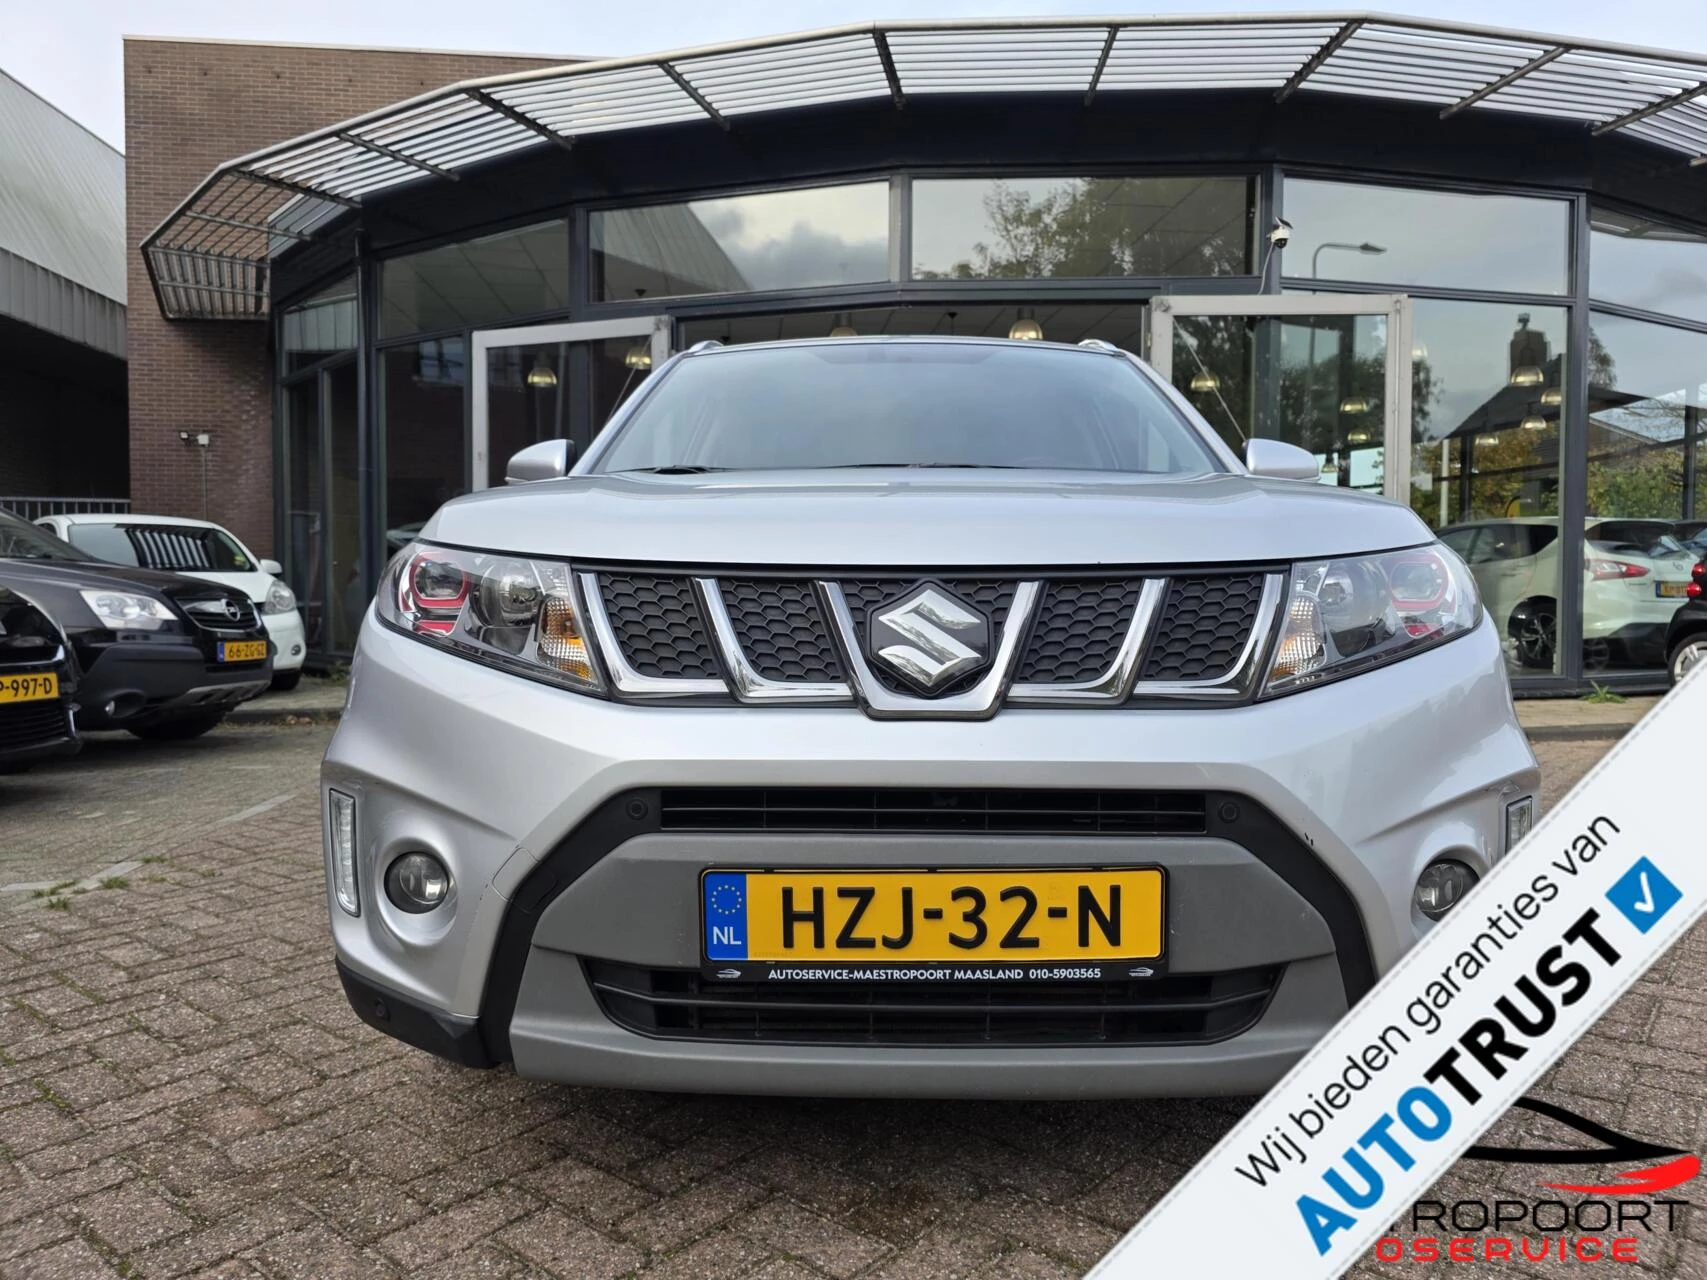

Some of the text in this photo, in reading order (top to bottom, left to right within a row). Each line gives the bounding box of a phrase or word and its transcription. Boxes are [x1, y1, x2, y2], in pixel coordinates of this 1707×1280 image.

[781, 885, 1121, 950] HZJ-32-N
[712, 926, 742, 945] NL
[768, 968, 1101, 981] AUTOSERVICE-MAESTROPOORT MAASLAND 010-5903565
